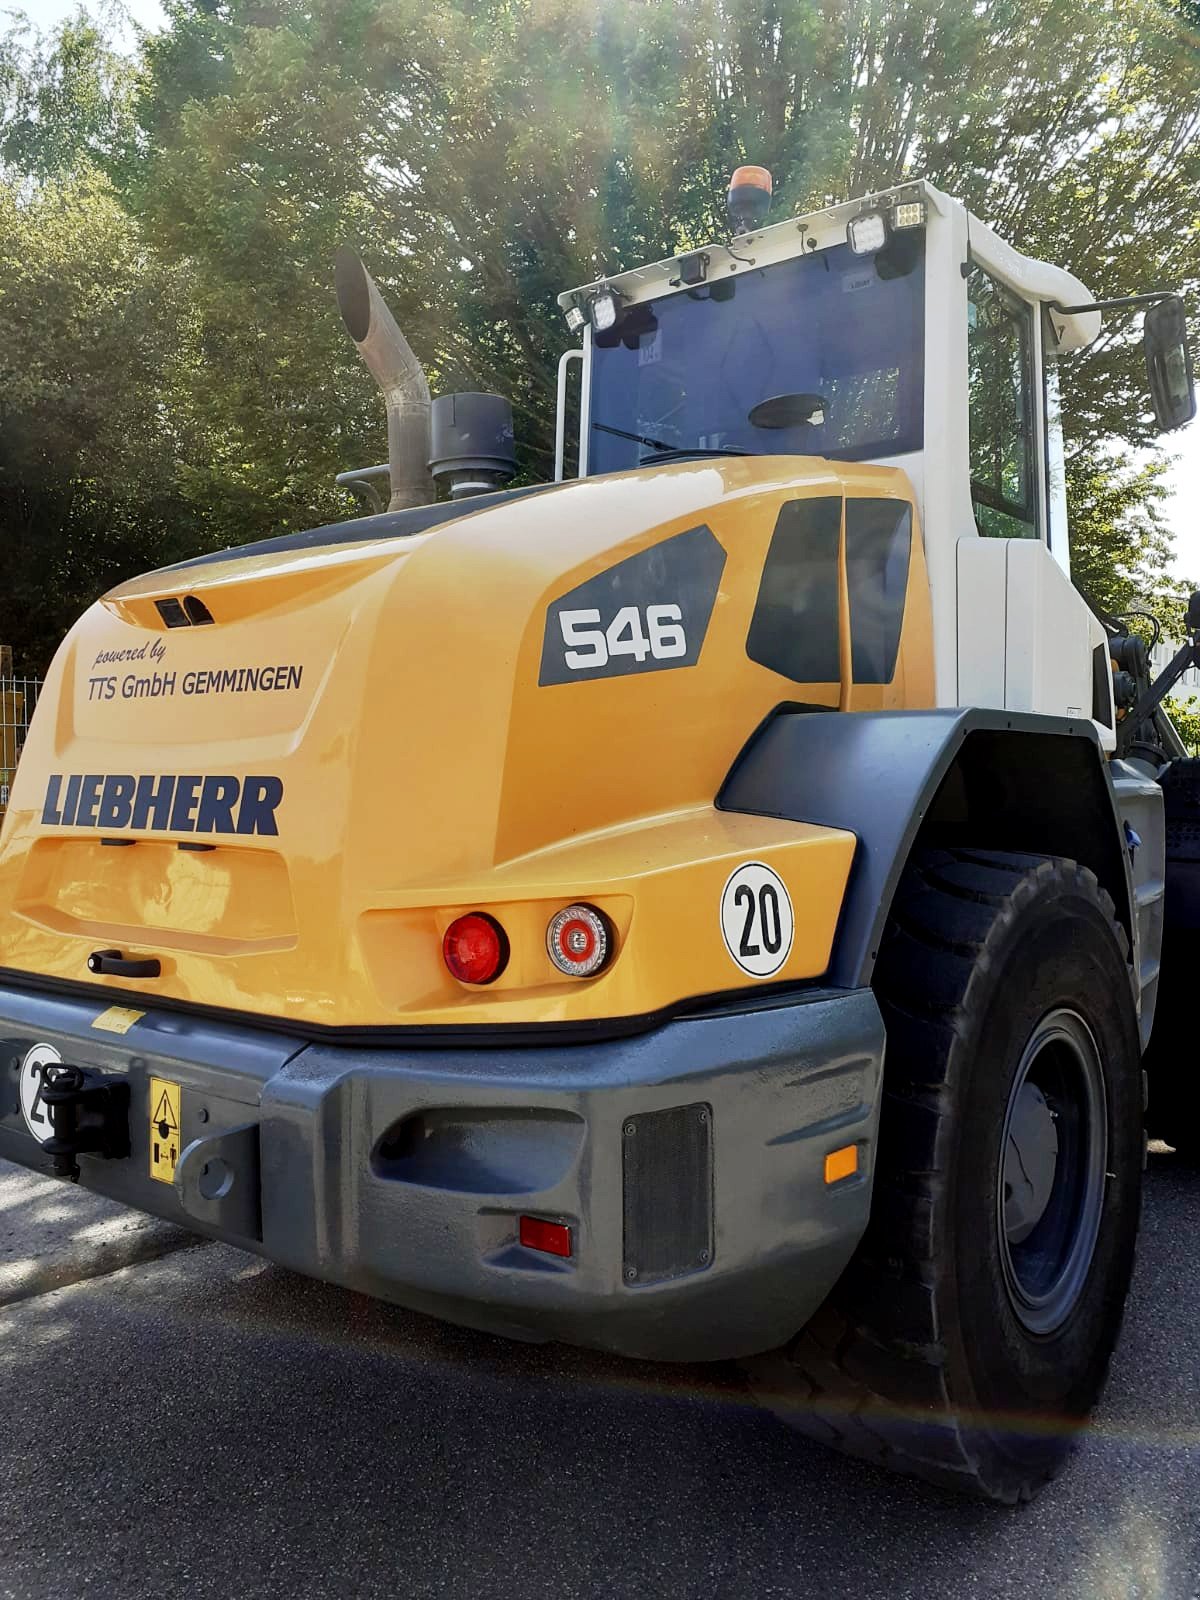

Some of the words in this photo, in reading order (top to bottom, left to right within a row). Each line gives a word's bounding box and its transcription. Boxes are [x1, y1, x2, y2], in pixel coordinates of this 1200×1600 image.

[92, 641, 150, 669] powered
[149, 637, 167, 663] by
[558, 604, 687, 670] 546
[88, 676, 116, 701] TTS
[122, 672, 177, 700] GmbH
[182, 665, 304, 695] GEMMINGEN
[41, 774, 284, 836] LIEBHERR
[734, 883, 782, 957] 20
